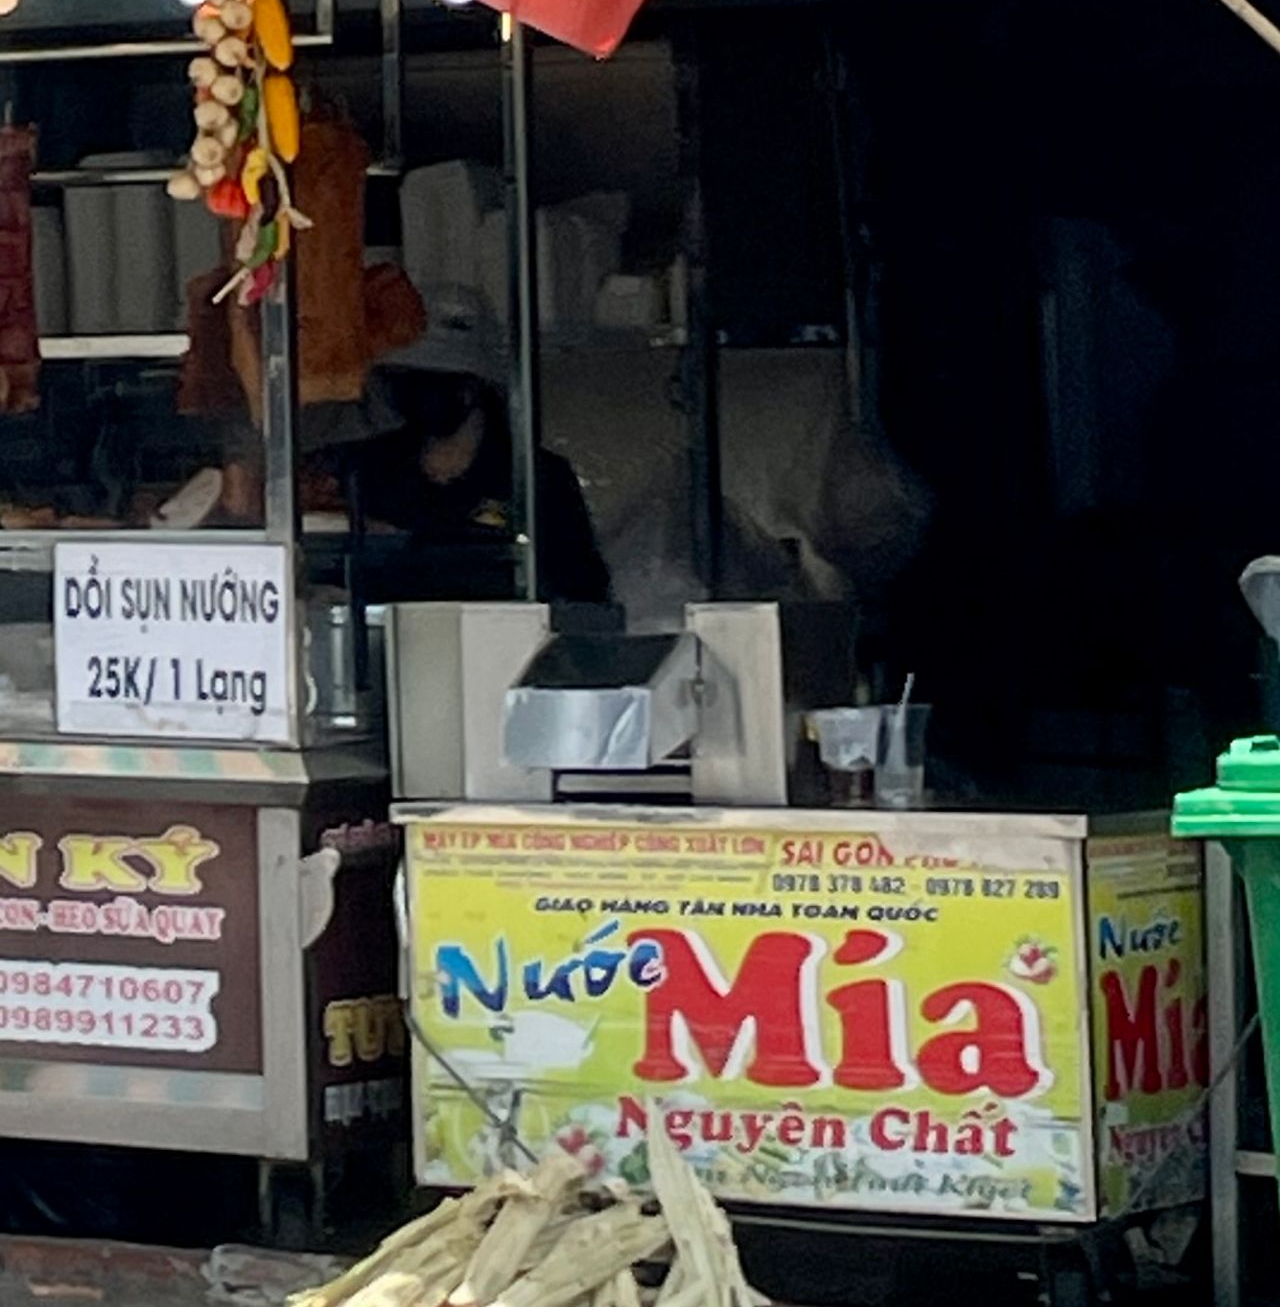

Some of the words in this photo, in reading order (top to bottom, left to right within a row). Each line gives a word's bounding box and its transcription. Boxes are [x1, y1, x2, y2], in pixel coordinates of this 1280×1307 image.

[196, 659, 268, 716] Lạng
[58, 825, 220, 894] KÝ
[436, 919, 668, 1019] Nước
[624, 928, 1052, 1099] Mía
[869, 1101, 1019, 1159] Chất
